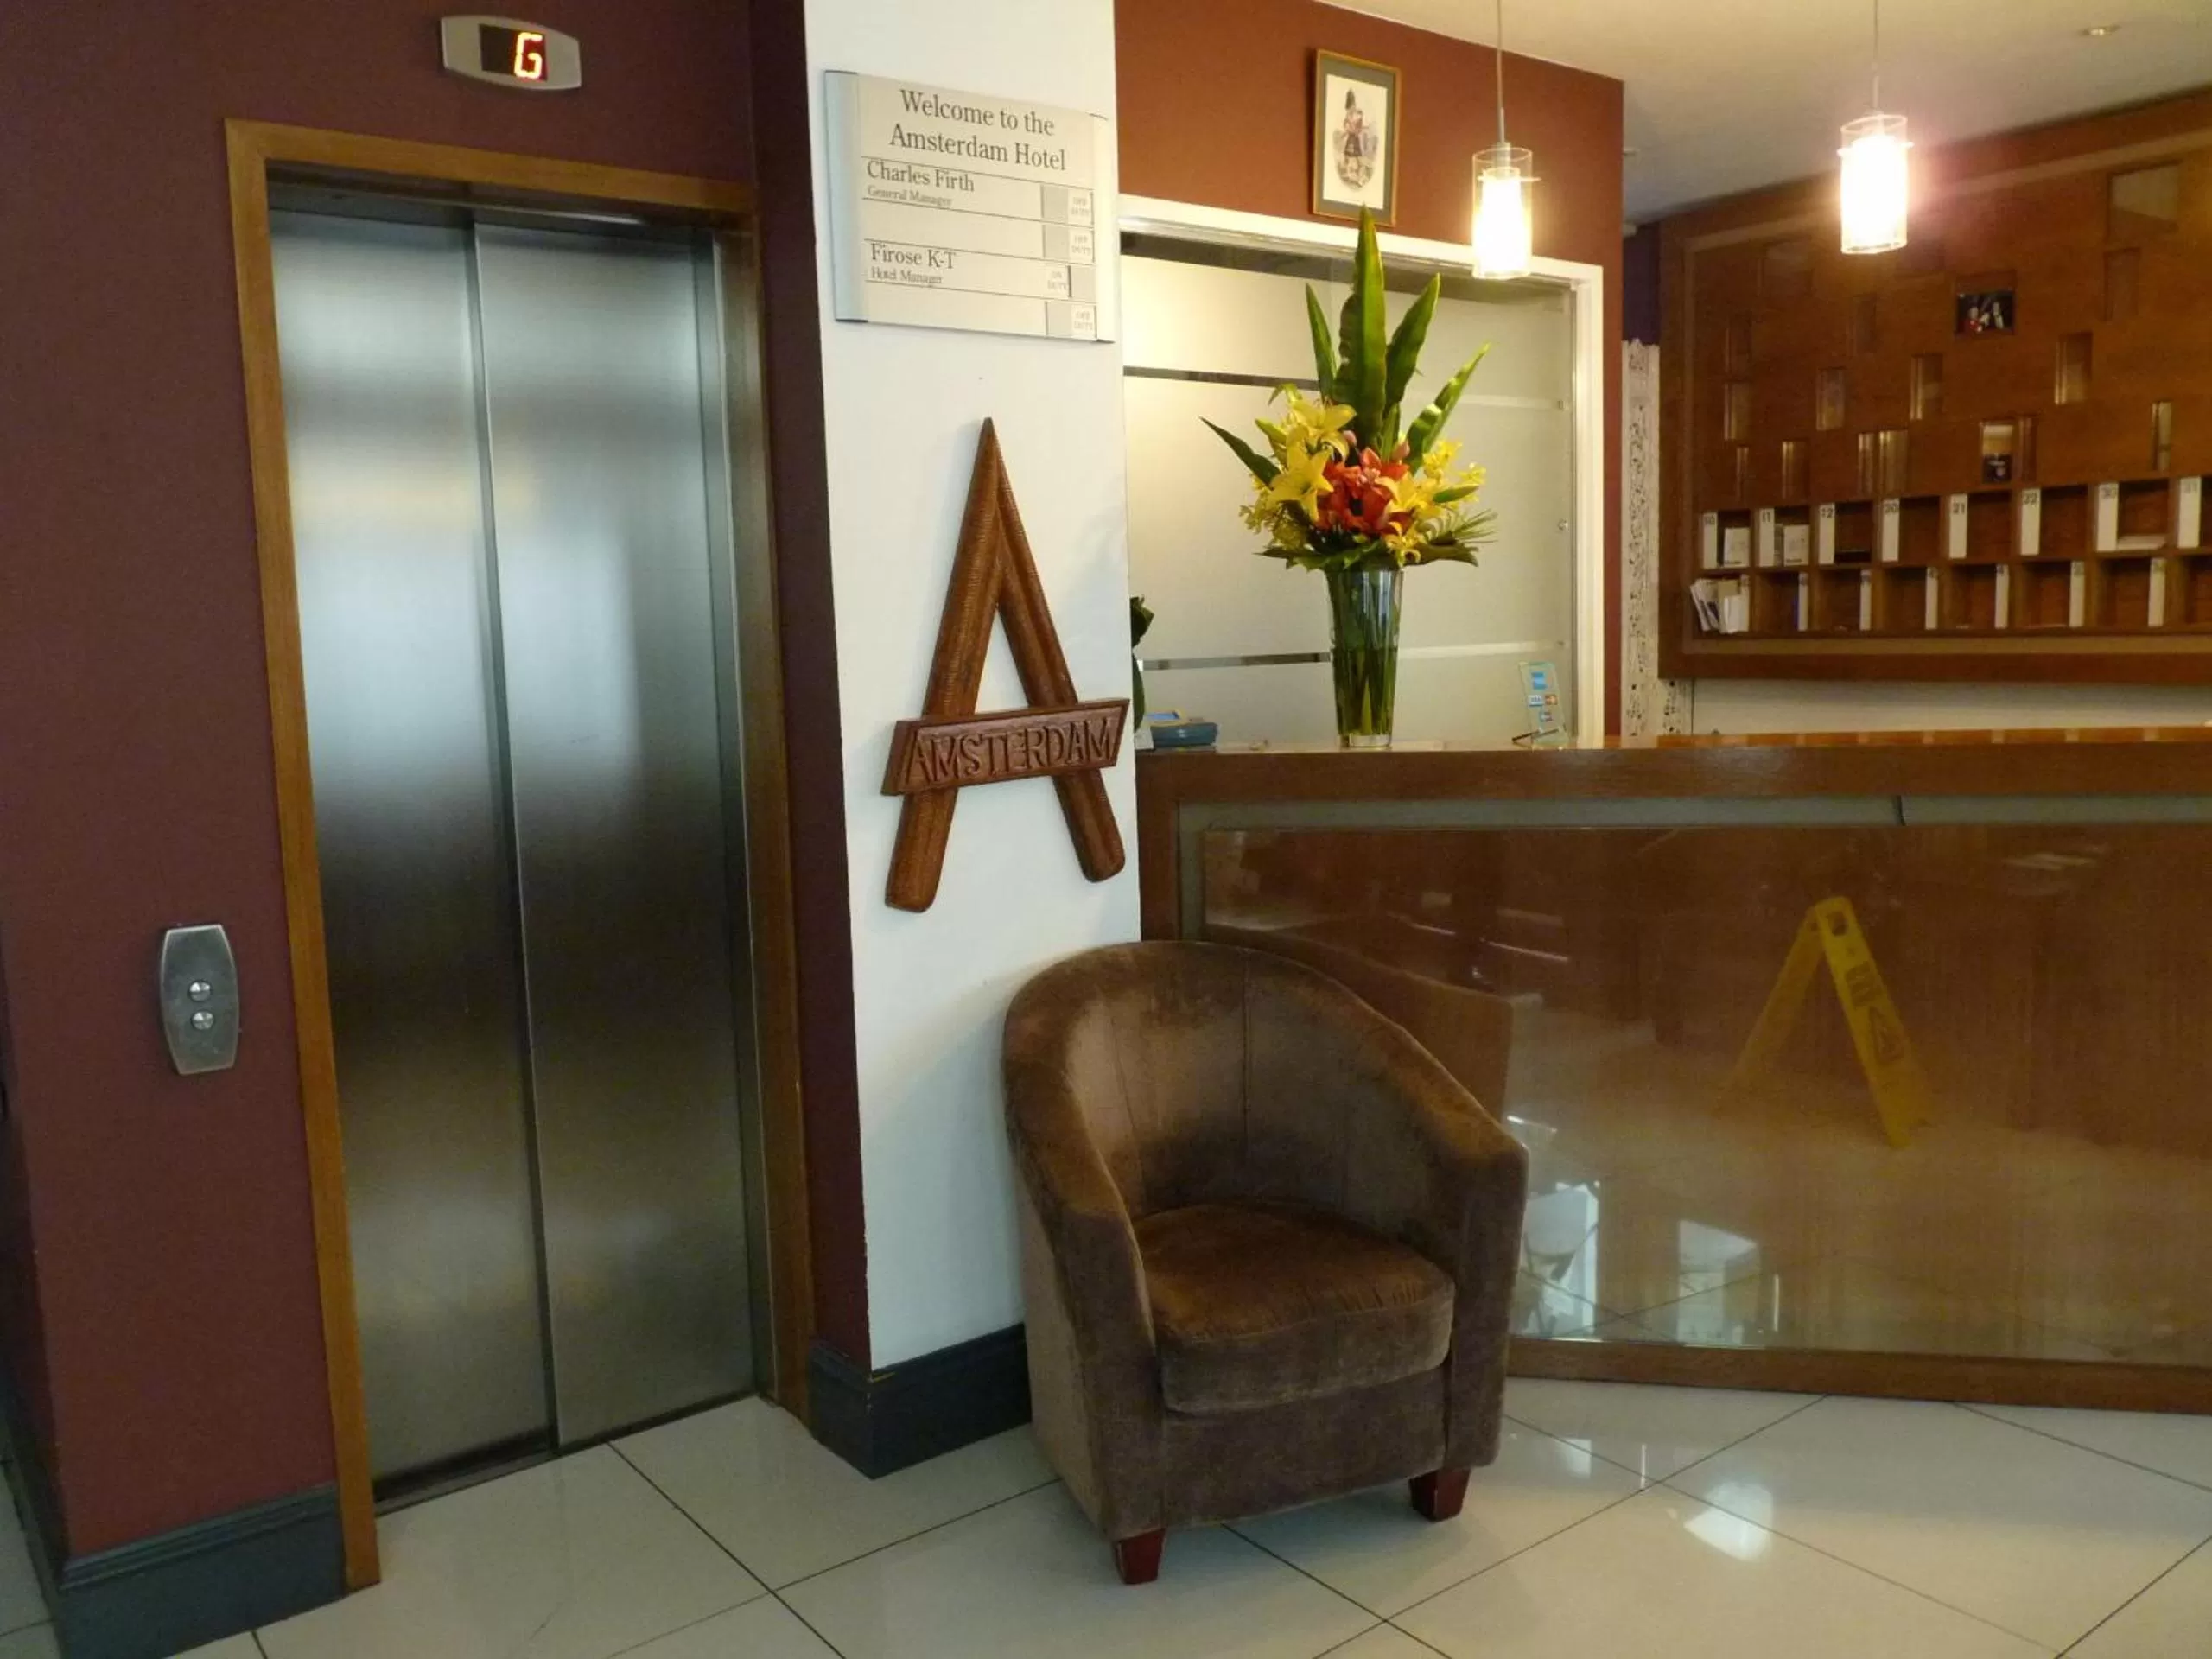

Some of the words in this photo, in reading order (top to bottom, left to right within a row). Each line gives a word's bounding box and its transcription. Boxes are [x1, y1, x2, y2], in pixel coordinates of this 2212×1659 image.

[514, 32, 543, 79] G
[899, 88, 995, 126] Welcome
[1000, 109, 1019, 130] to
[1024, 111, 1055, 136] the
[889, 122, 1009, 162] Amsterdam
[1014, 142, 1067, 171] Hotel
[867, 160, 931, 186] Charles
[935, 168, 975, 192] Firth
[871, 242, 923, 265] Firose
[927, 249, 957, 270] K-T
[906, 715, 1116, 785] AMSTERDAM
